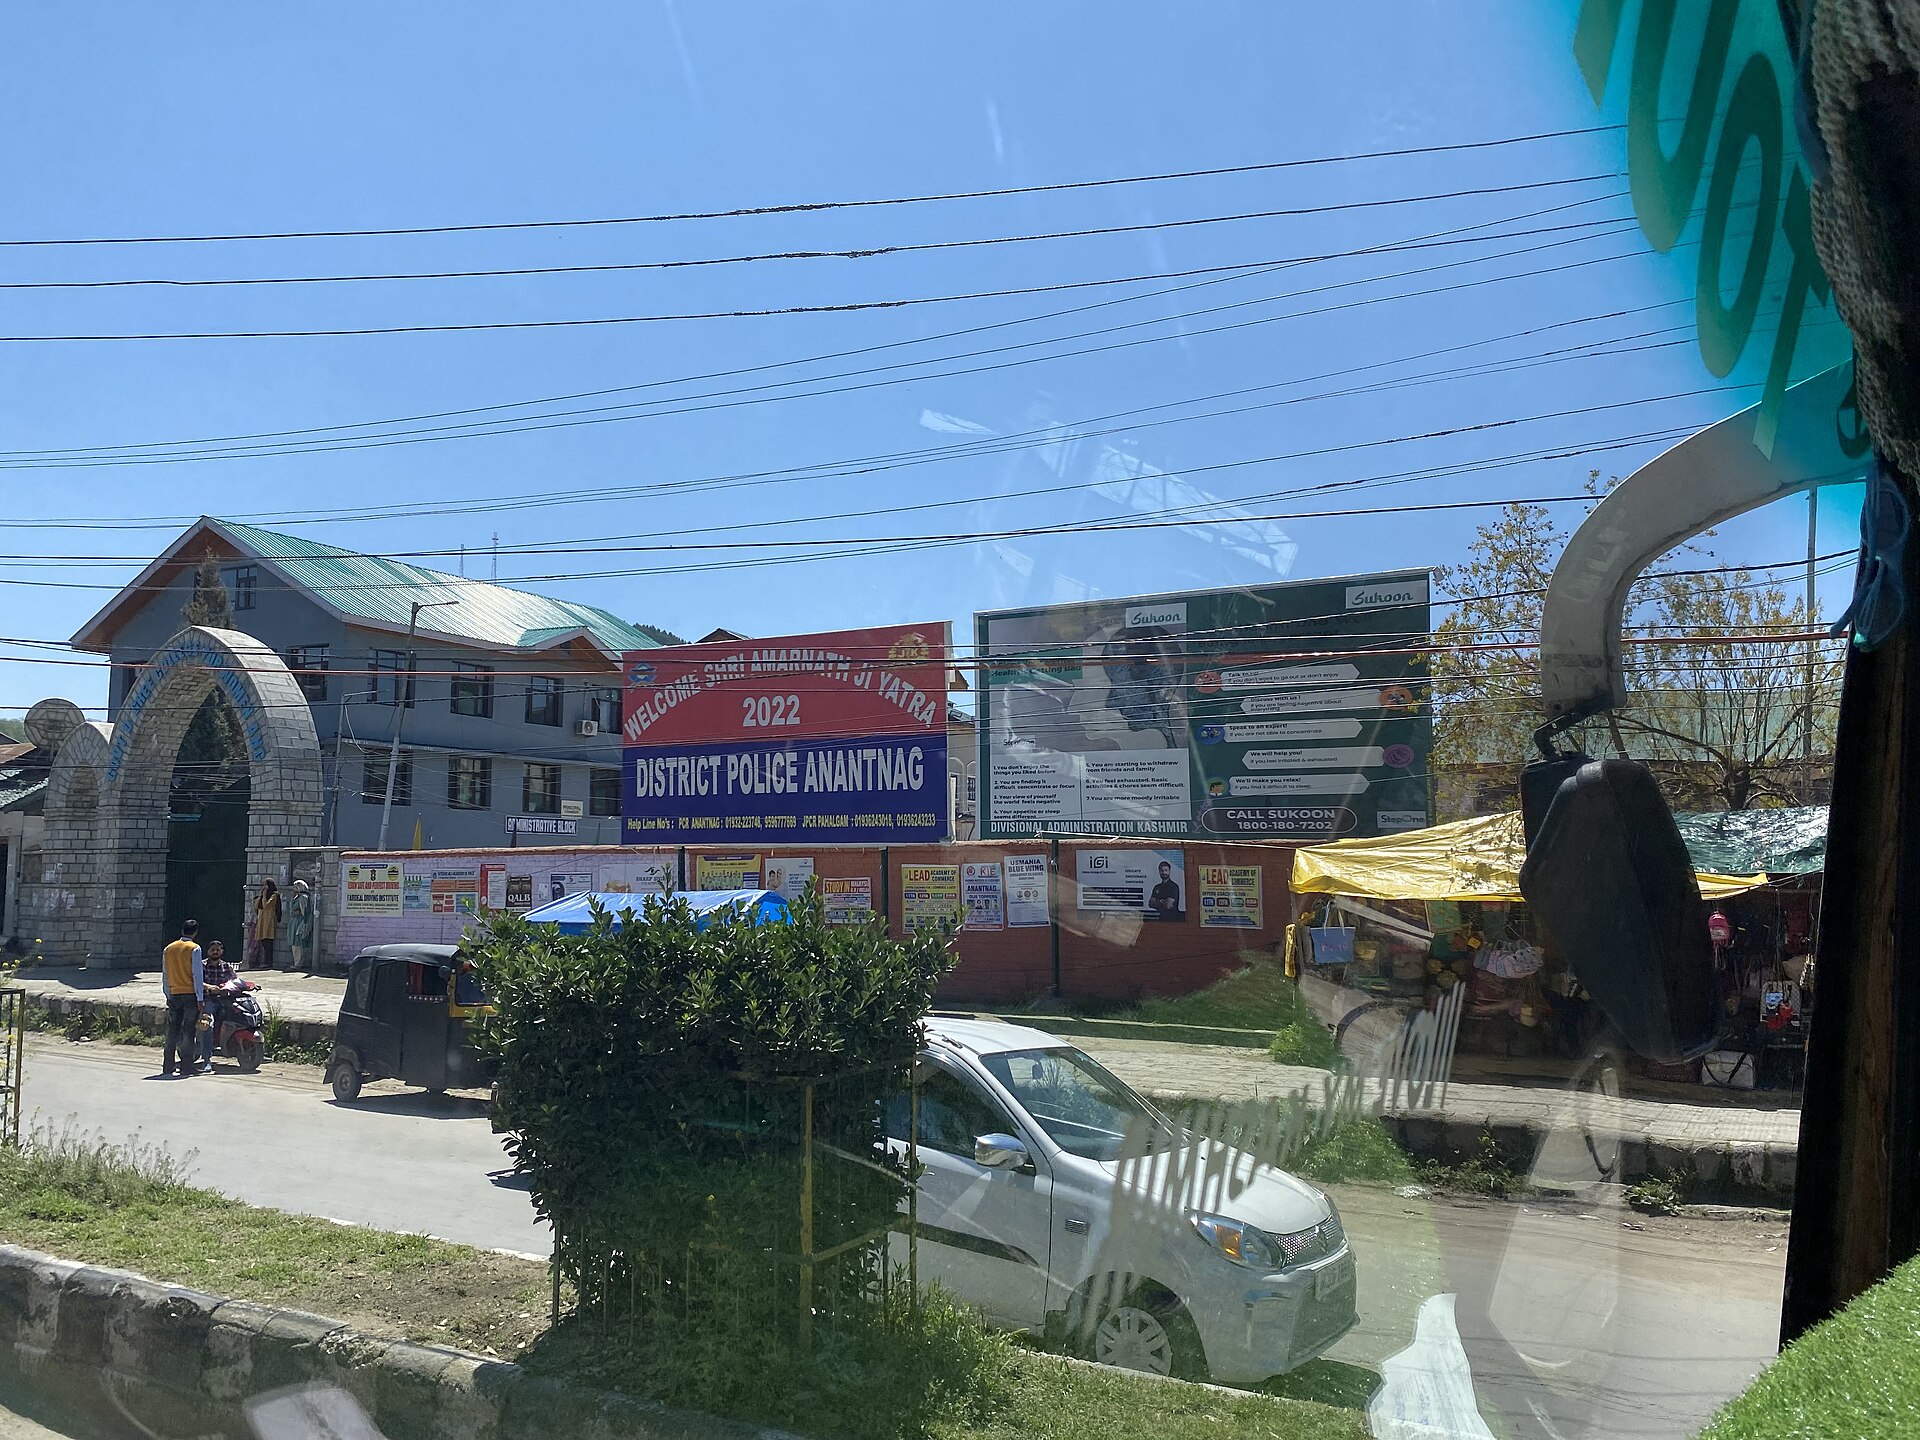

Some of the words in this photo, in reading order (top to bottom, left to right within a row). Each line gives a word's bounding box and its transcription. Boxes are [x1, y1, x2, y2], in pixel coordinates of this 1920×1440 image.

[1352, 590, 1414, 606] Sukoon
[1131, 612, 1182, 625] Sukoon
[624, 669, 701, 741] WELCOME
[704, 653, 745, 687] SHRI
[751, 649, 851, 682] AMARNATH
[877, 671, 937, 728] YATRA
[743, 694, 801, 727] 2022
[636, 754, 721, 798] DISTRICT
[727, 751, 798, 795] POLICE
[803, 746, 924, 793] ANANTNAG
[1226, 809, 1264, 819] CALL
[1267, 808, 1336, 819] SUKOON
[1380, 814, 1426, 824] StepOne
[557, 820, 577, 834] BLOCK
[627, 817, 641, 832] Help
[642, 817, 656, 829] Line
[678, 816, 690, 829] PCR
[817, 814, 849, 828] PAHALGAM
[990, 821, 1042, 833] DIVISIONAL
[1047, 821, 1133, 833] ADMINISTRATION
[1137, 820, 1188, 833] KASHMIR
[1237, 820, 1333, 830] 1800-180-7202
[909, 869, 930, 881] LEAD
[1008, 865, 1024, 873] BLUE
[1025, 864, 1044, 872] WING
[1206, 868, 1229, 885] LEAD
[825, 881, 843, 893] STUDY
